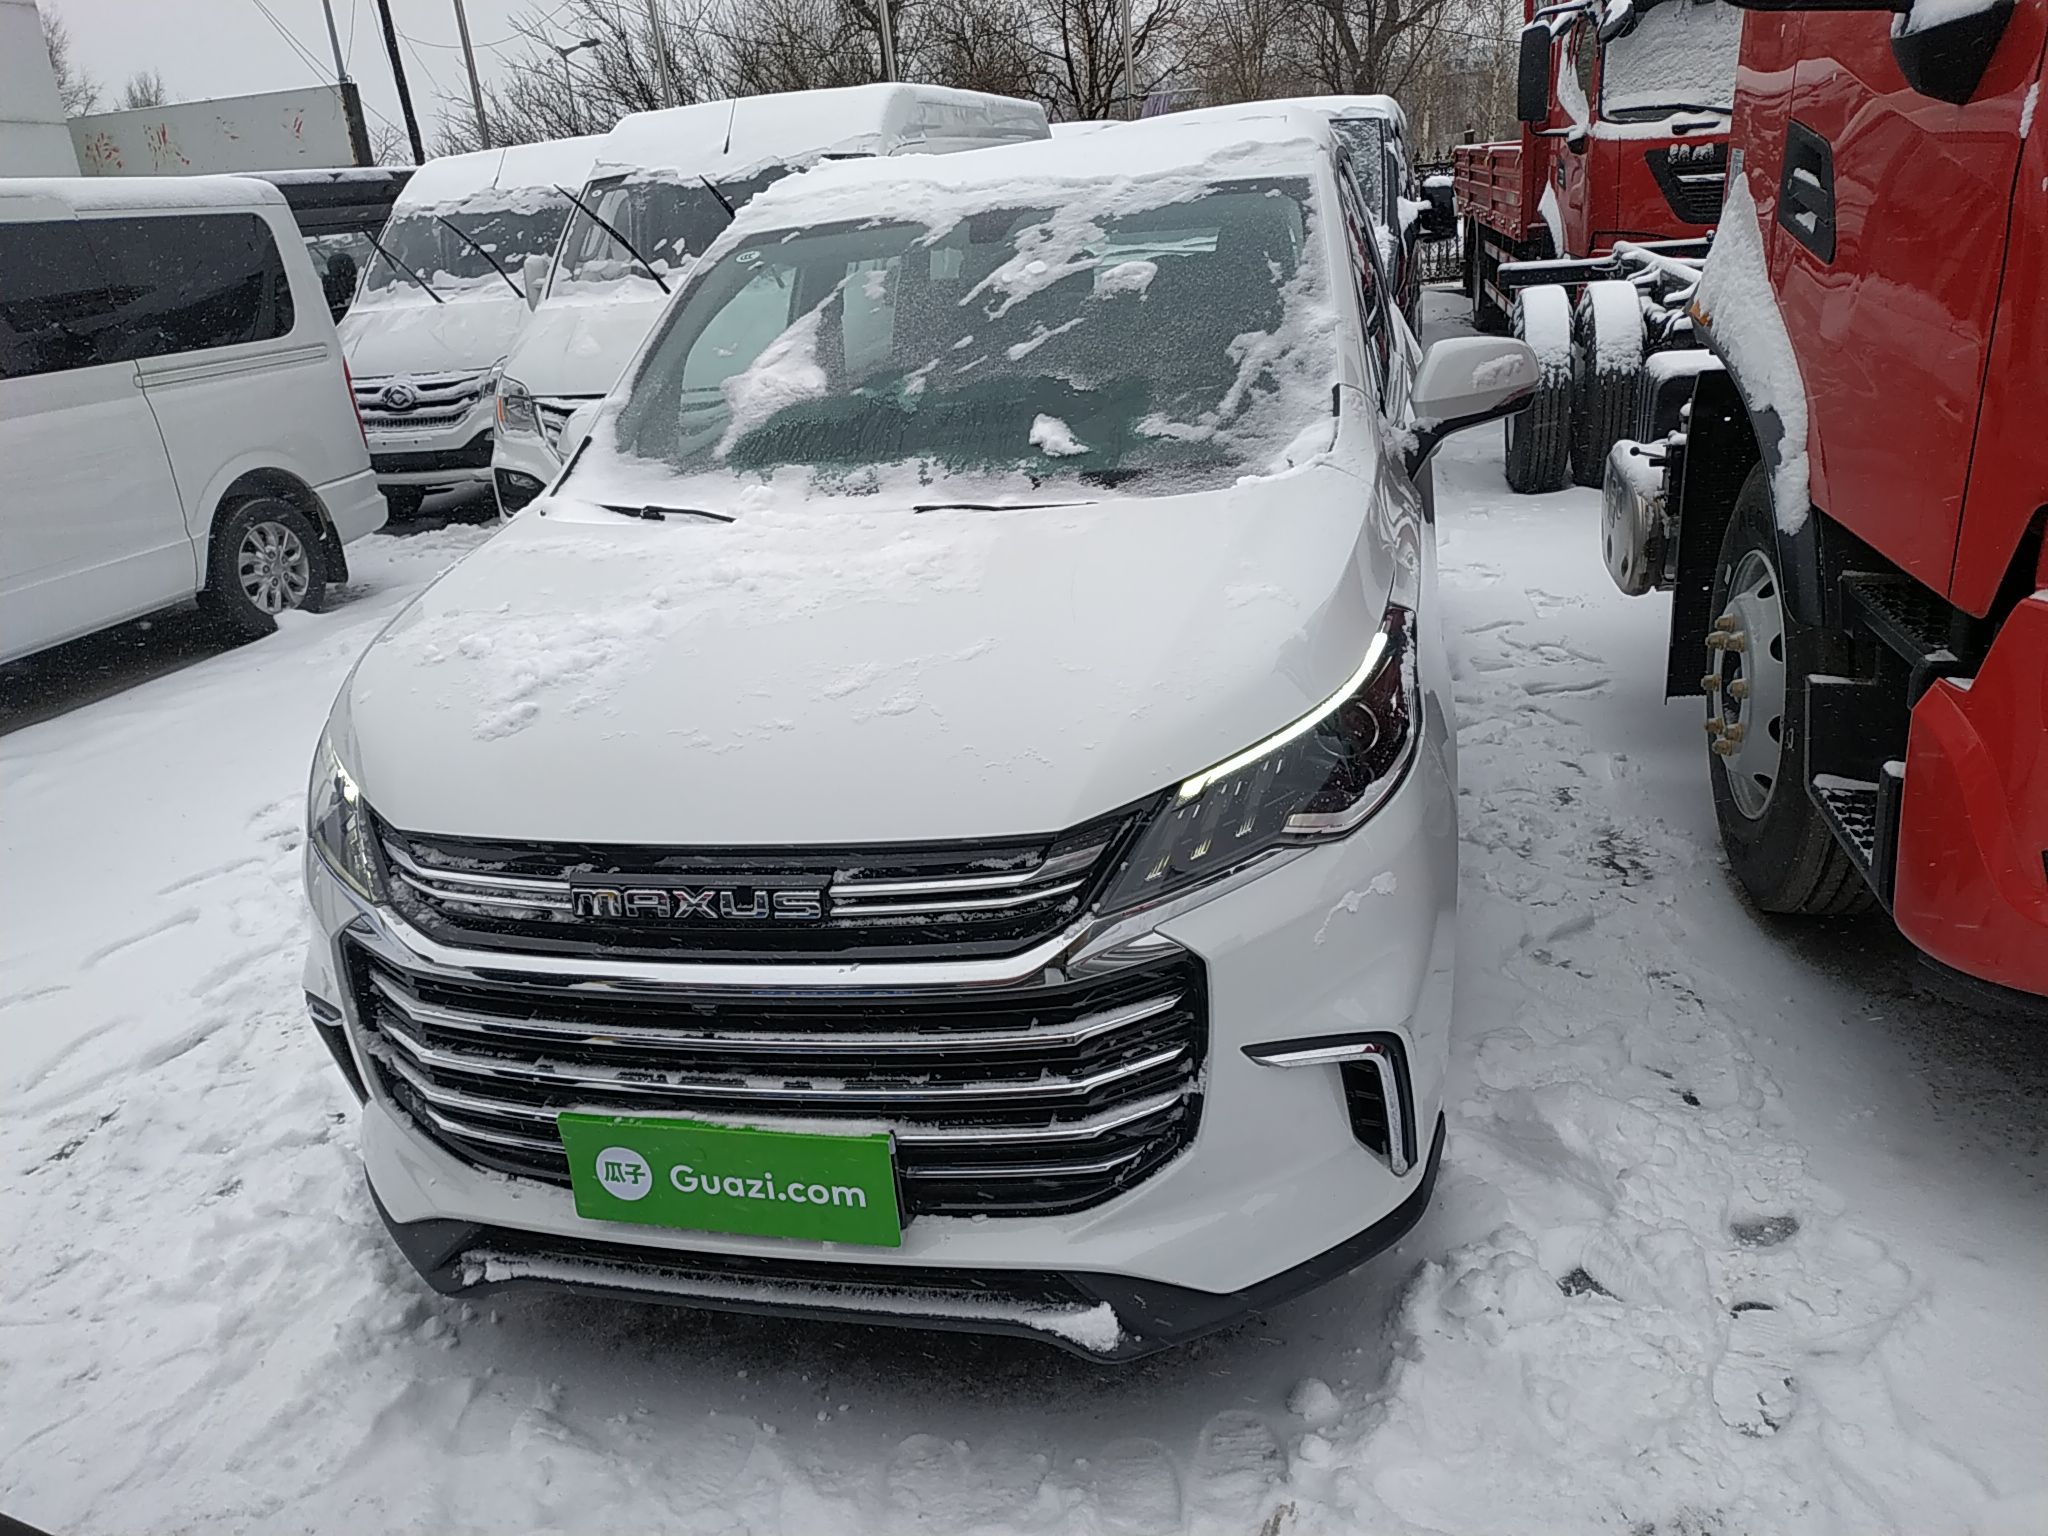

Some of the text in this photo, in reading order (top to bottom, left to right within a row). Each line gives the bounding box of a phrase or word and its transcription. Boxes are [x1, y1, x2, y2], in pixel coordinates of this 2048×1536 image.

[571, 888, 822, 920] MAXUS
[604, 1161, 646, 1185] 瓜子
[669, 1164, 867, 1208] Guazi.com
